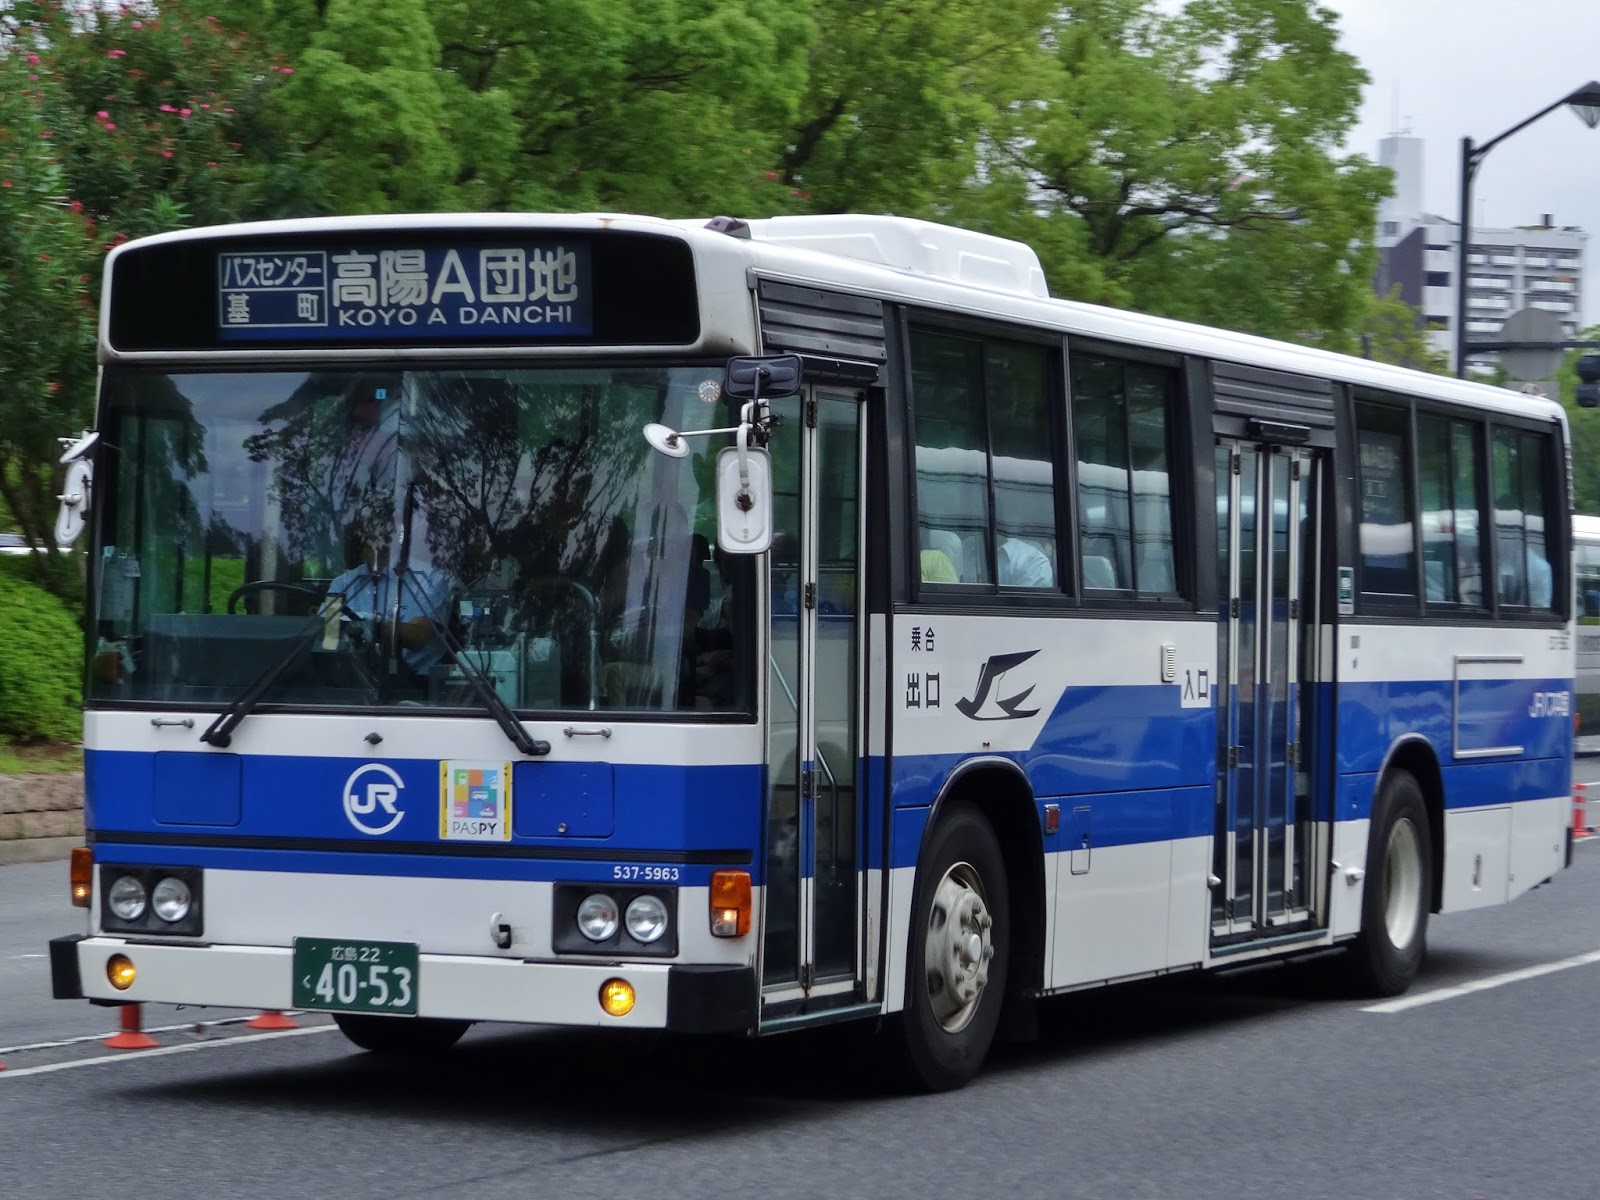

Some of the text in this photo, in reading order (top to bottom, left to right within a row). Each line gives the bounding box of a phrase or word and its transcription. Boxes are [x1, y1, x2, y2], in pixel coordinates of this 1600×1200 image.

[224, 256, 322, 287] バスセンター
[332, 247, 578, 307] 高陽A団地
[339, 305, 573, 326] KOYO A DANCHI
[911, 627, 935, 652] 乗合
[906, 672, 940, 708] 出口
[1184, 669, 1209, 700] 入口
[350, 784, 398, 813] JR
[453, 822, 498, 836] PASPY
[613, 866, 679, 880] 537-5963
[316, 962, 412, 1007] 40-53
